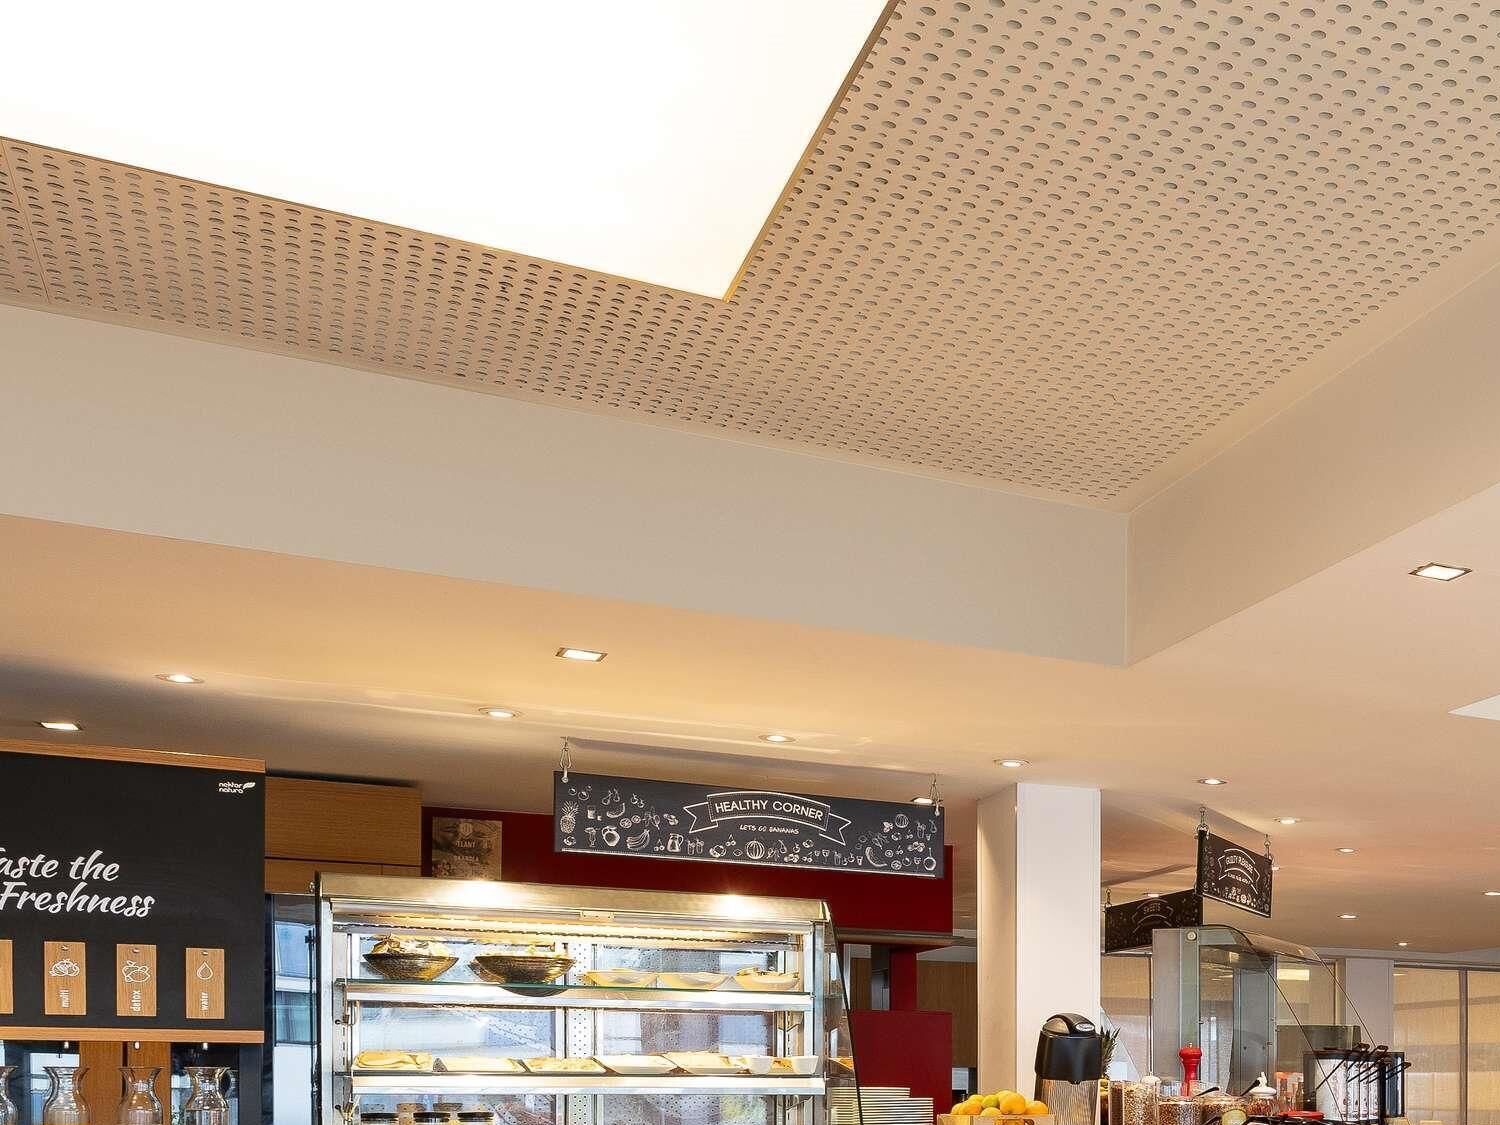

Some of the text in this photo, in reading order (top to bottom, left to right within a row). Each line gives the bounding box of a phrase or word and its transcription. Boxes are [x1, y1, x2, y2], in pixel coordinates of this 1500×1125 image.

[715, 799, 823, 821] HEALTHY CORNER
[769, 826, 800, 835] BANANAS
[0, 847, 120, 881] aste the
[0, 881, 155, 917] Freshness
[130, 990, 141, 1012] detox
